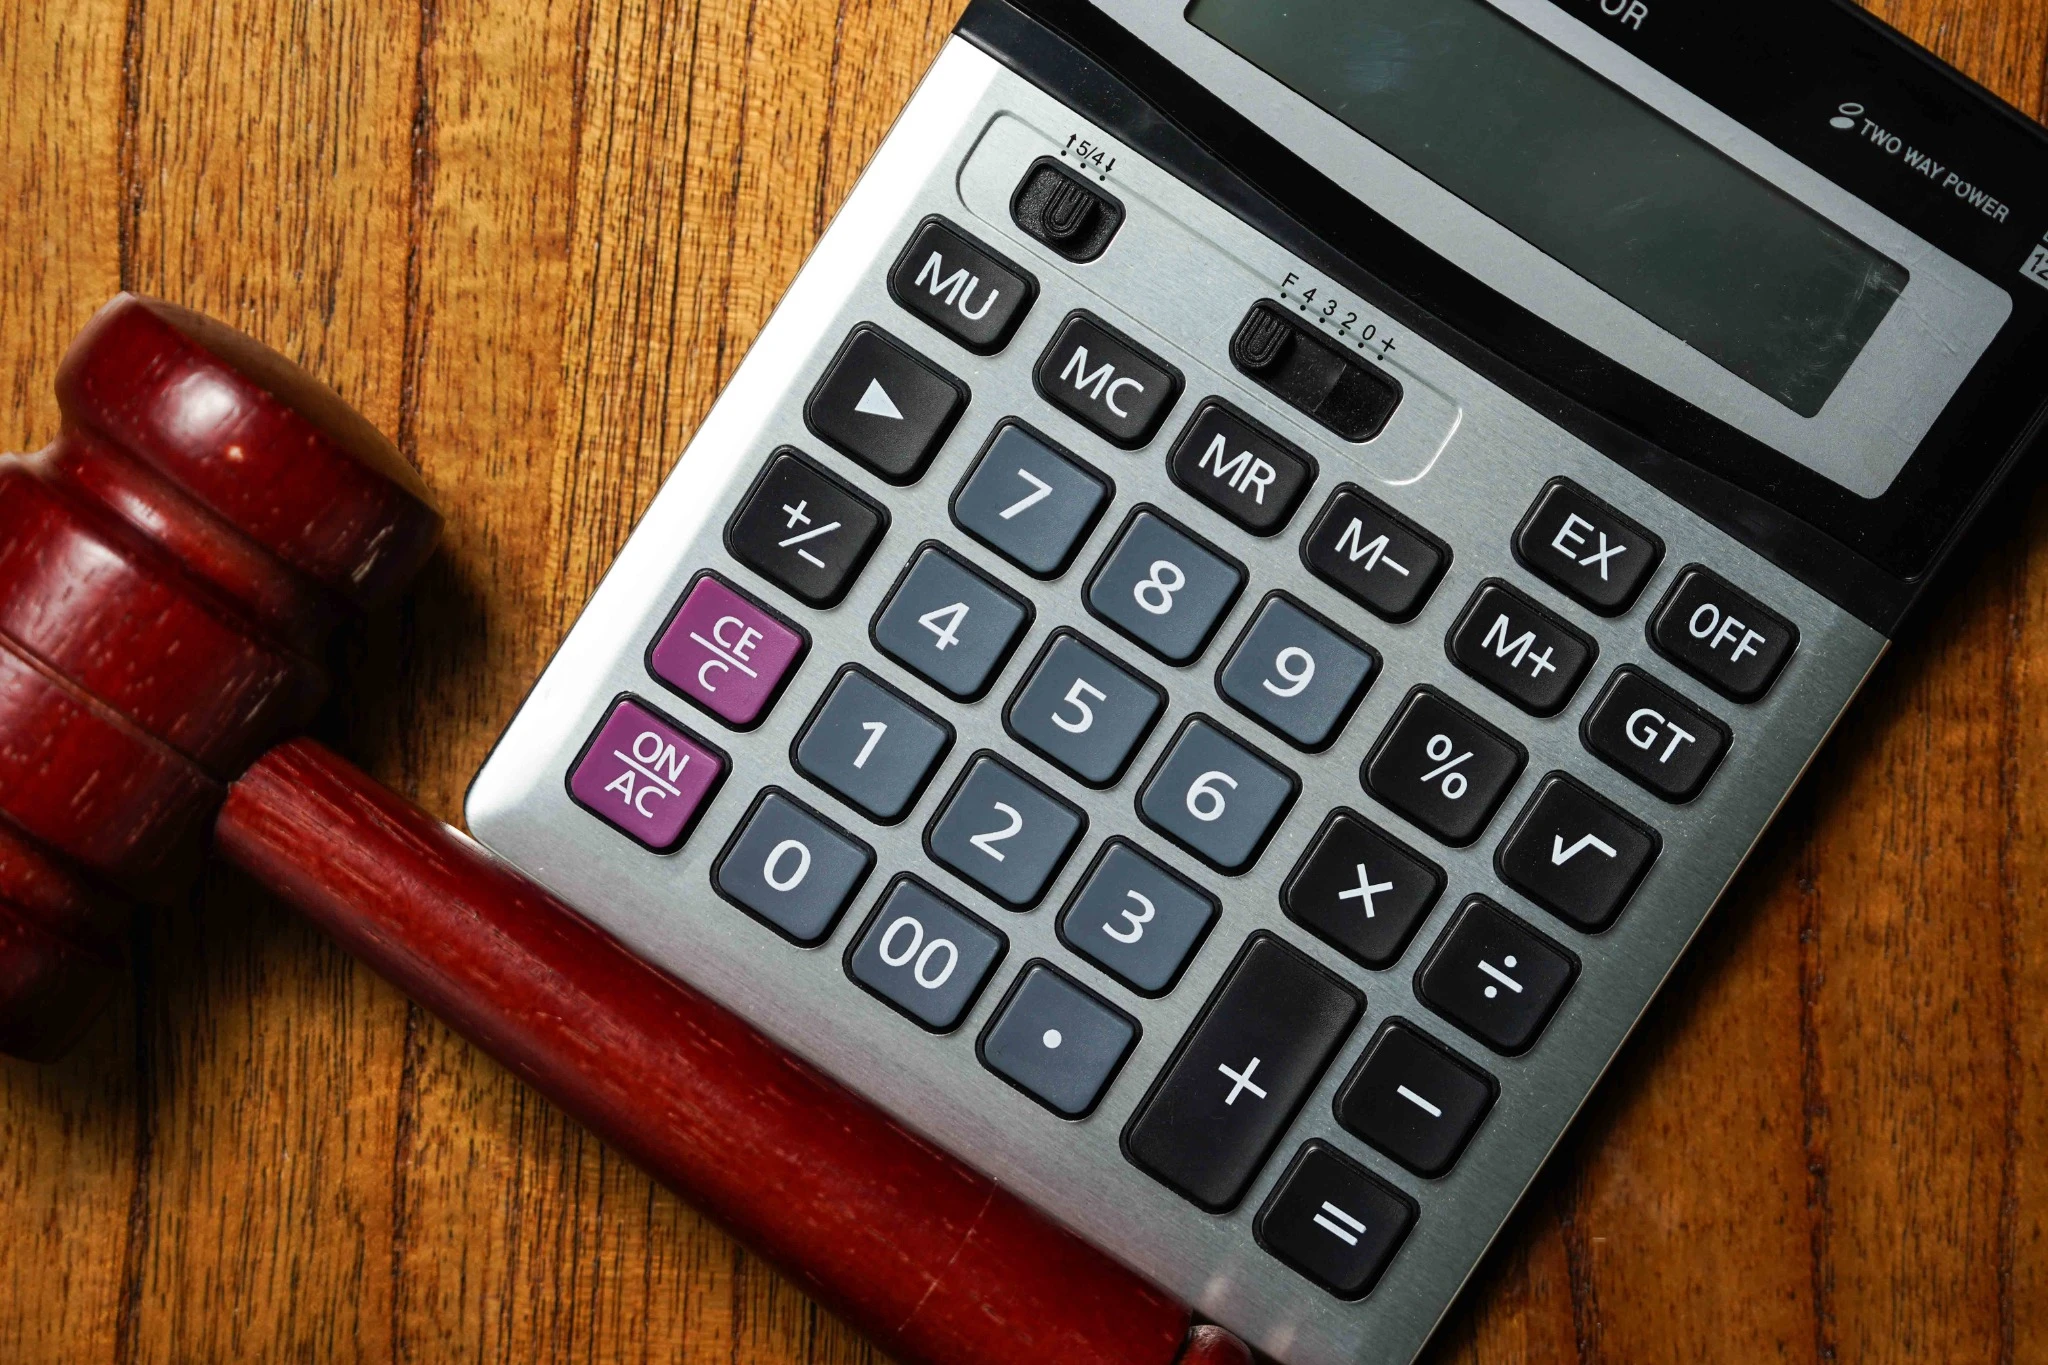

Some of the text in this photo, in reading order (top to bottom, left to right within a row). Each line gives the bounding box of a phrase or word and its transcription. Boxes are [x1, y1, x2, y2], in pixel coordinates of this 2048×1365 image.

[1075, 139, 1104, 167] 5/4
[1860, 118, 2010, 224] TWO WAY POWER
[913, 250, 999, 321] MU
[1058, 345, 1145, 418] MC
[999, 468, 1053, 519] 7
[1197, 432, 1277, 505] MR
[1551, 512, 1627, 581] EX
[1133, 560, 1186, 615] 8
[712, 615, 764, 663] CE
[918, 602, 970, 651] 4
[1480, 613, 1557, 679] M+
[1689, 603, 1766, 662] OFF
[698, 658, 730, 692] C
[1262, 646, 1315, 697] 9
[1050, 677, 1107, 733] 5
[631, 730, 691, 782] ON
[852, 720, 888, 770] 1
[1625, 707, 1696, 764] GT
[604, 769, 656, 818] AC
[1420, 733, 1474, 800] %
[1186, 770, 1238, 821] 6
[969, 801, 1023, 862] 2
[763, 839, 811, 892] 0
[1102, 889, 1155, 944] 3
[879, 916, 958, 989] 00
